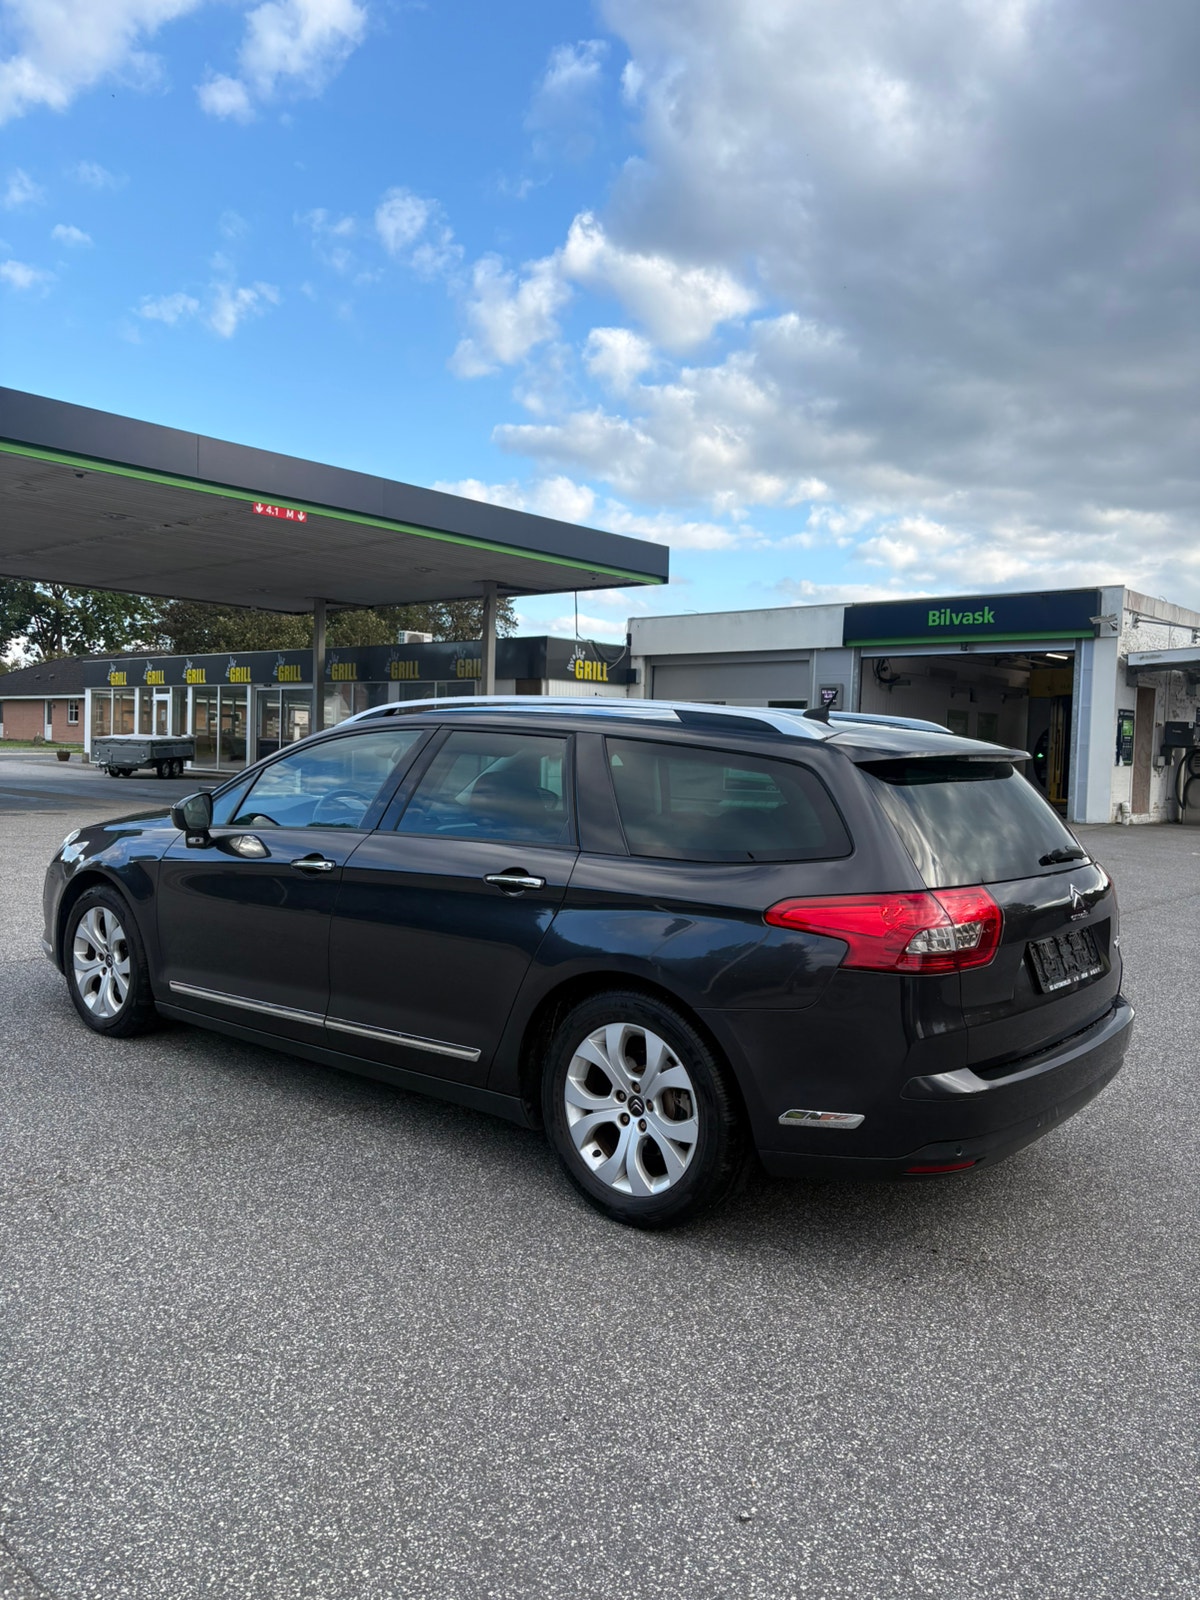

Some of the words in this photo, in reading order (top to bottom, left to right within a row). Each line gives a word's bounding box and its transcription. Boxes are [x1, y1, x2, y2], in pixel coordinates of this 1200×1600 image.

[266, 505, 279, 516] 4.1
[286, 509, 294, 519] M
[928, 606, 995, 626] Bilvask
[186, 668, 206, 684] GRILL
[229, 666, 252, 683] GRILL
[277, 664, 302, 682] GRILL
[331, 663, 358, 681] GRILL
[391, 660, 420, 680] GRILL
[456, 658, 481, 678] GRIL
[575, 659, 609, 682] GRILL
[110, 671, 127, 686] GRILL
[146, 670, 165, 685] GRILL
